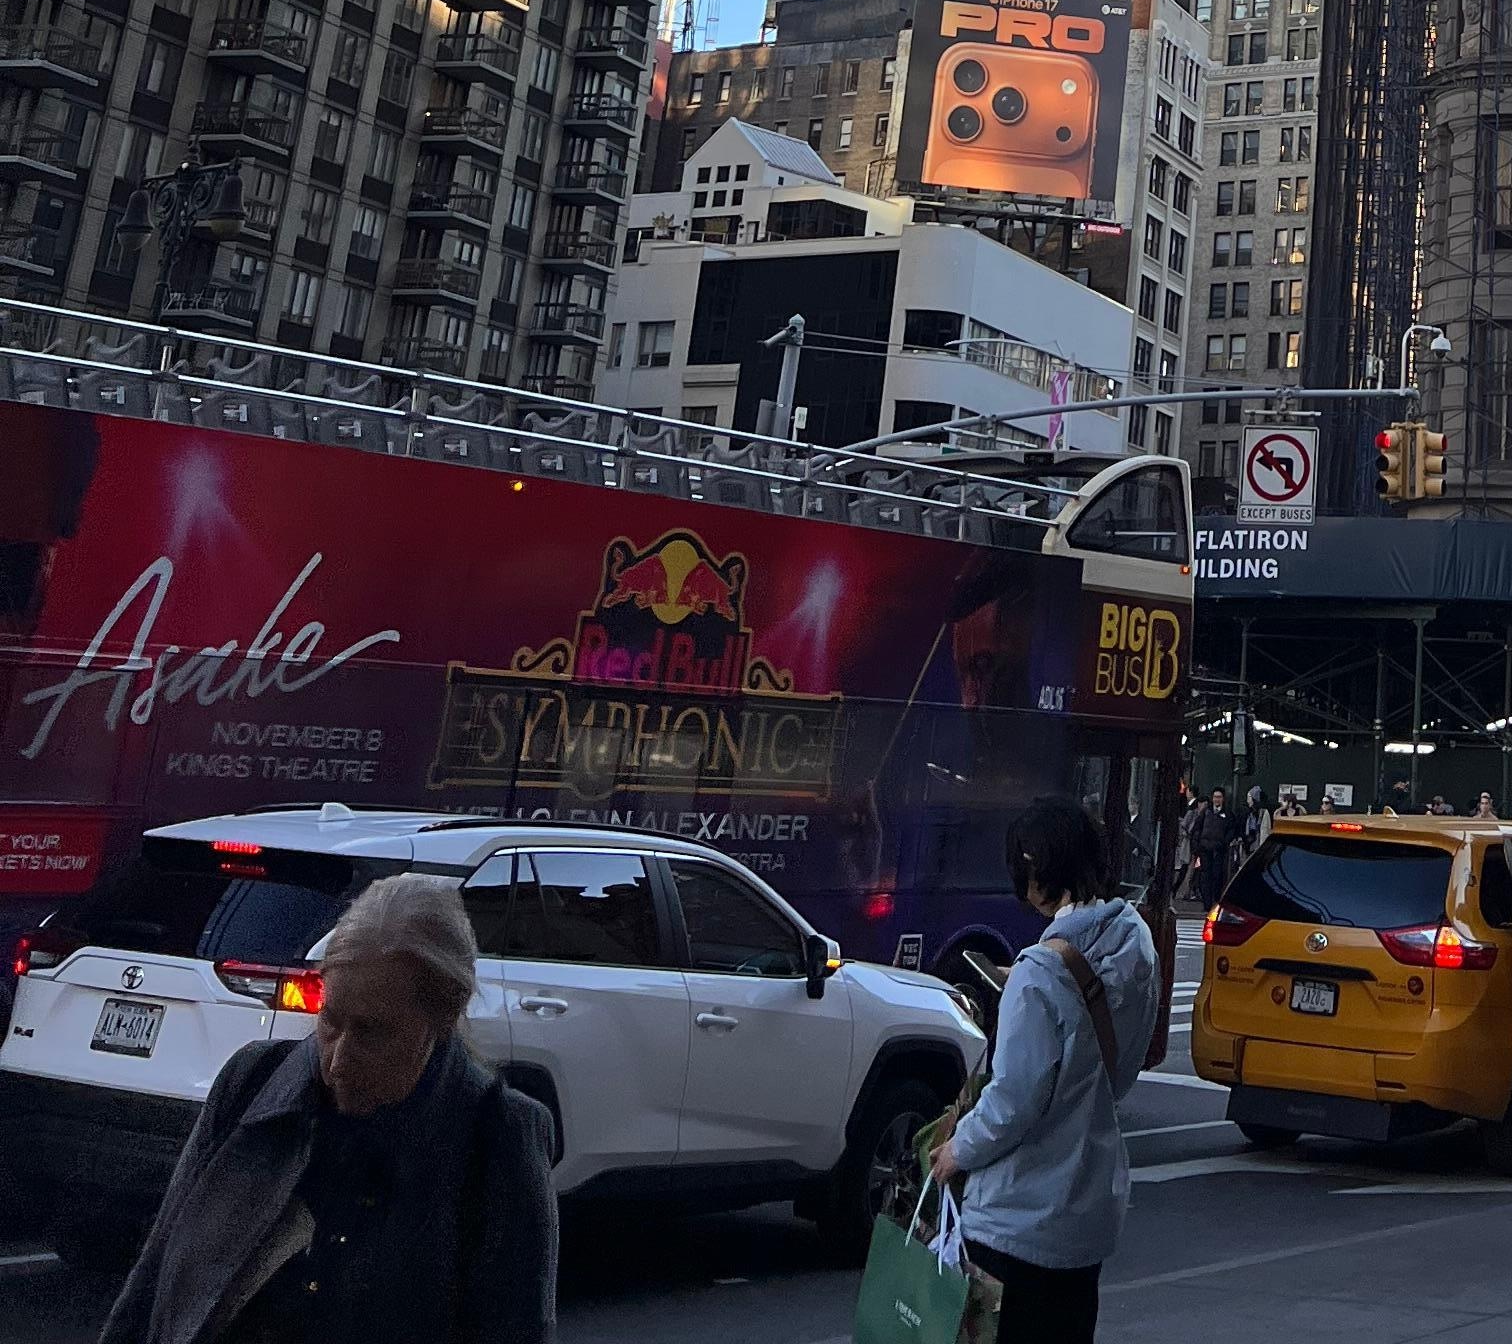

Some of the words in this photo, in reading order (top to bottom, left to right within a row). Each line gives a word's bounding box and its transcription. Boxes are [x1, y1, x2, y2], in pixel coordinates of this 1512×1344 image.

[939, 0, 1106, 54] PRO
[1241, 507, 1276, 520] EXCEPT
[1280, 508, 1312, 520] BUSES
[1195, 530, 1308, 551] FLATIRON
[1100, 603, 1148, 652] BIG
[20, 552, 401, 759] Asake
[578, 624, 663, 690] Red
[666, 632, 746, 696] Bull
[1095, 653, 1143, 697] BUS
[211, 721, 365, 750] NOVEMBER
[366, 728, 384, 751] 8
[479, 689, 804, 774] SYMPHONIC
[166, 753, 250, 779] KINGS
[259, 757, 379, 783] THEATRE
[641, 811, 809, 841] ALEXANDER
[11, 834, 61, 850] YOUR
[45, 855, 89, 870] NOW
